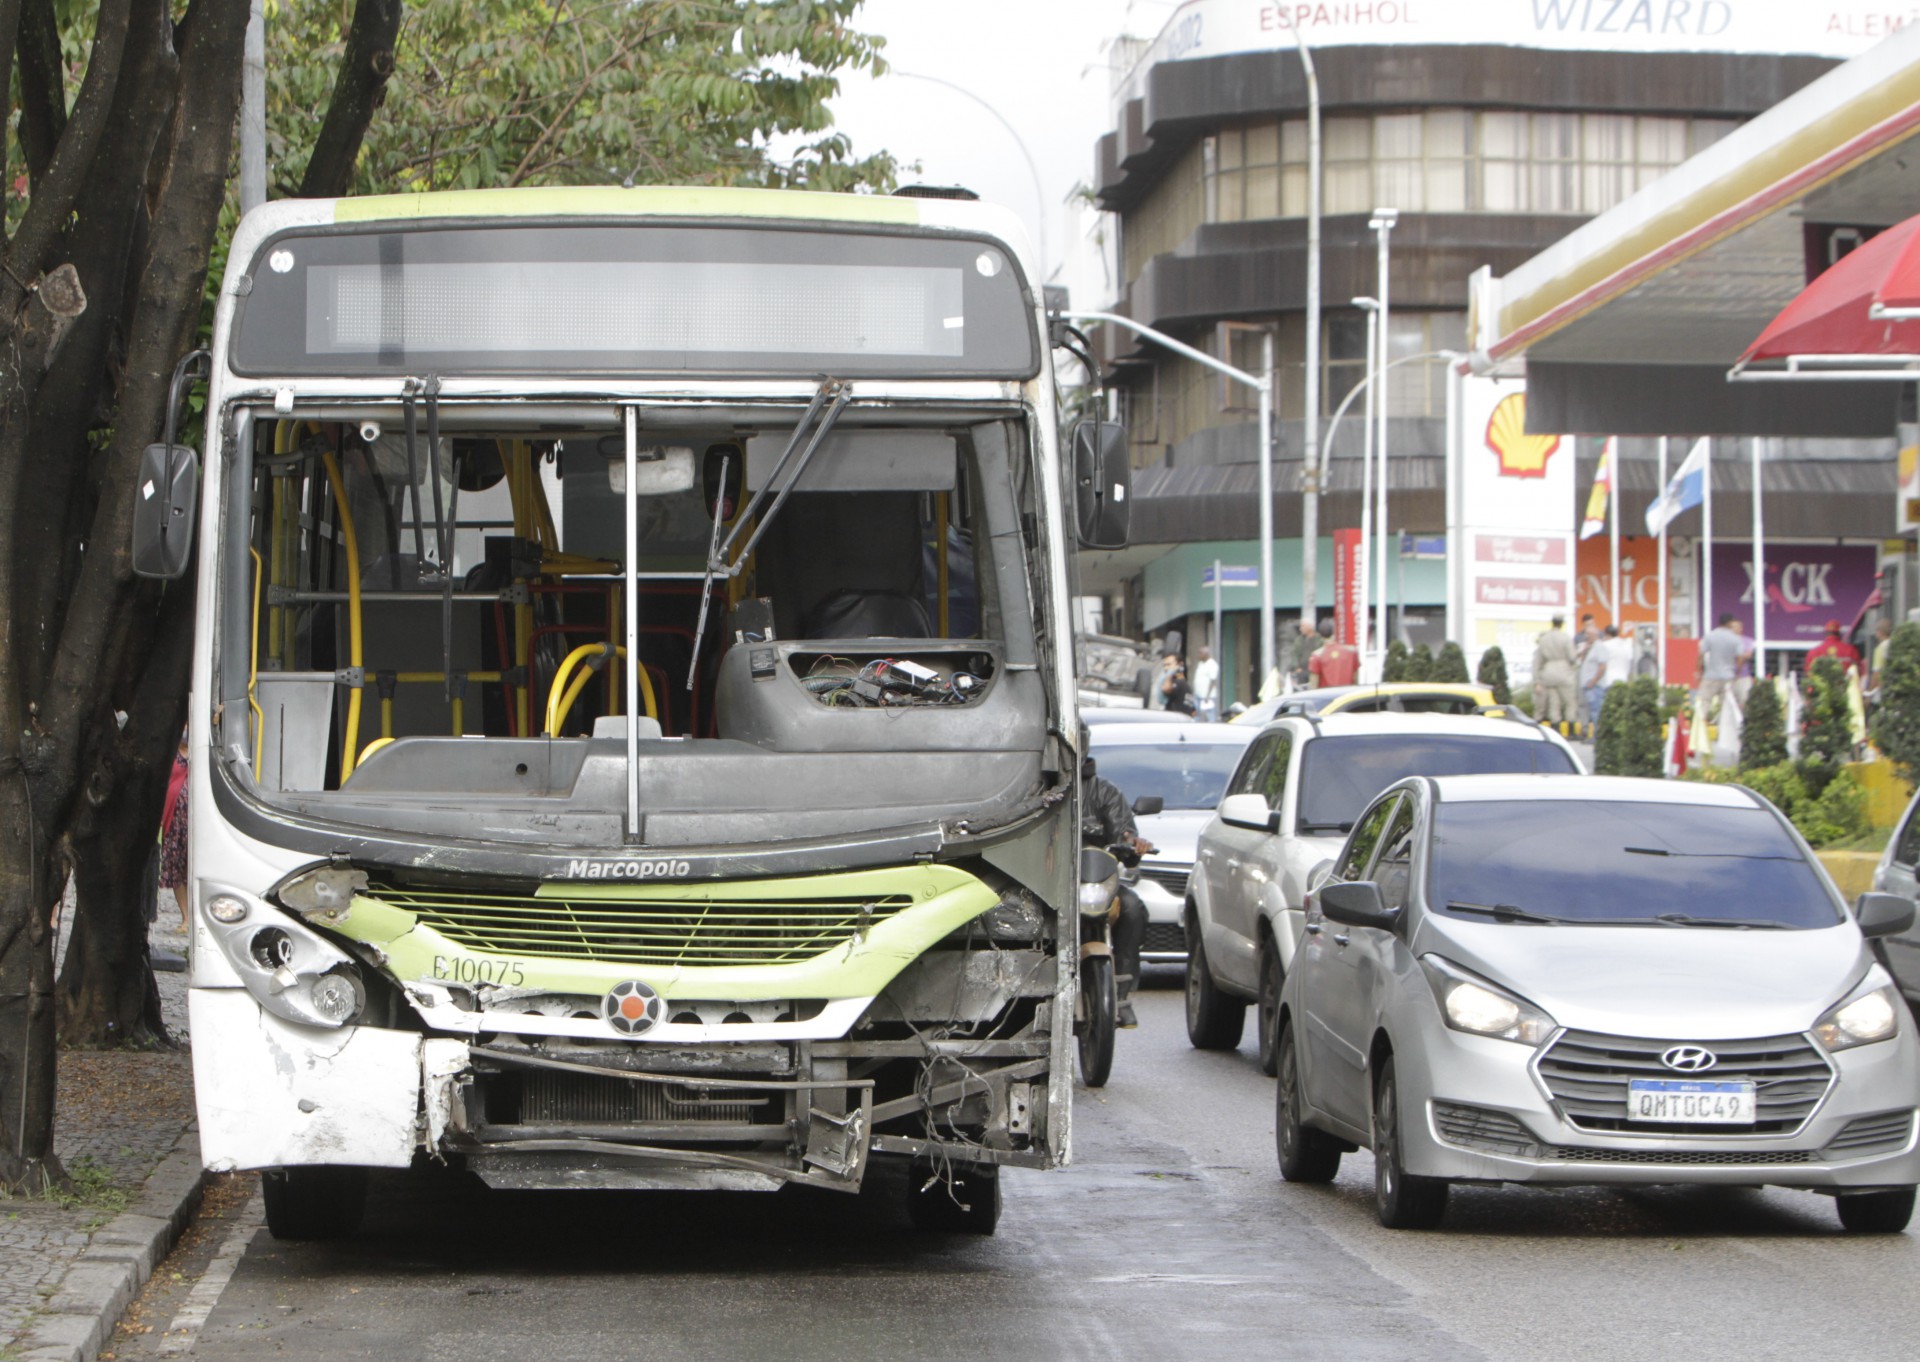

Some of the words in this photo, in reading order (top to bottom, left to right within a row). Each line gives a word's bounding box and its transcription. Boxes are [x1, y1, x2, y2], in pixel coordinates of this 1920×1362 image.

[1260, 1, 1418, 31] ESPANHOL
[1530, 0, 1733, 35] WIZARD
[568, 860, 690, 878] Marcopolo
